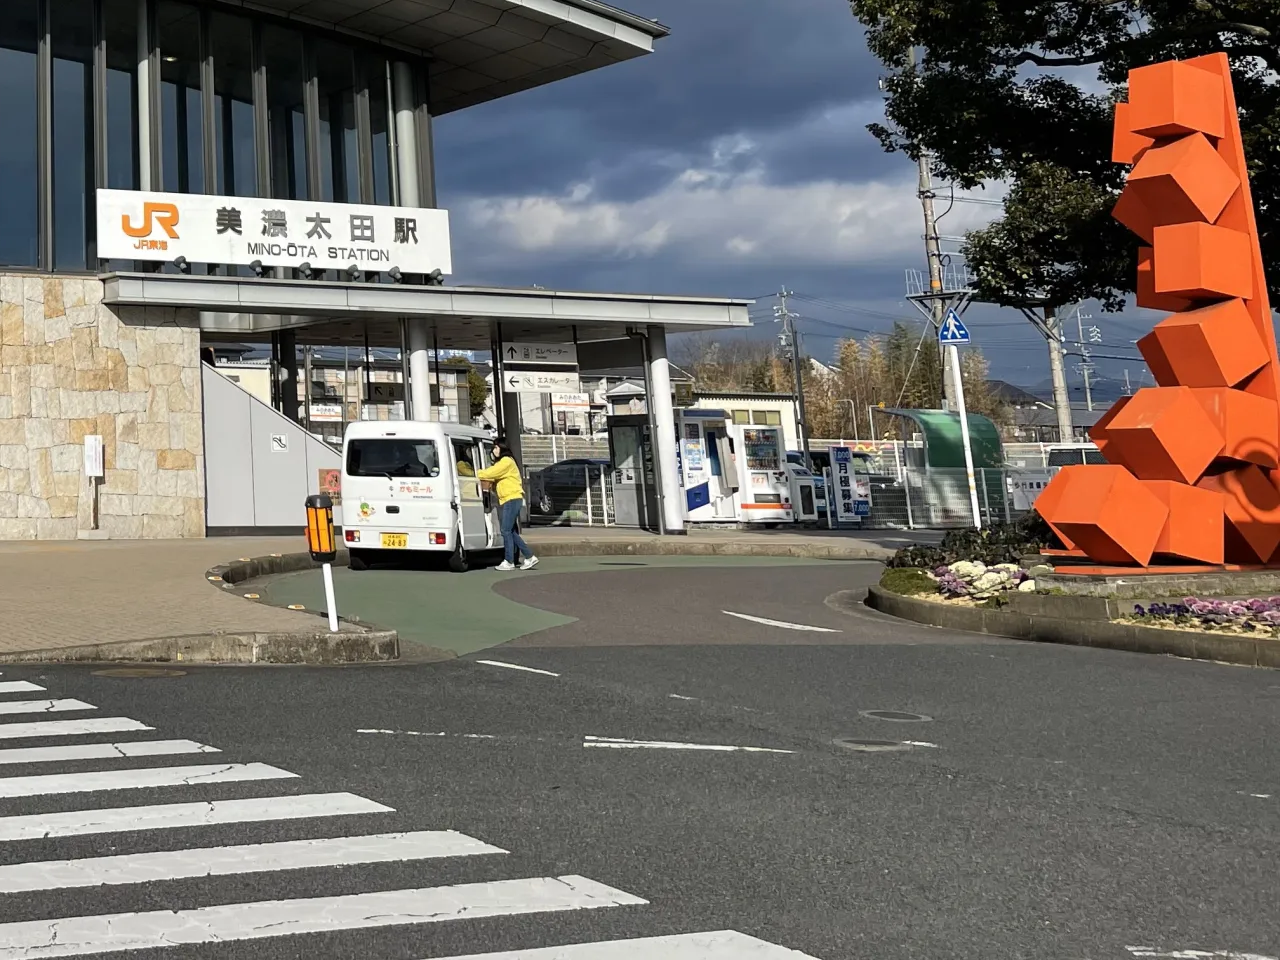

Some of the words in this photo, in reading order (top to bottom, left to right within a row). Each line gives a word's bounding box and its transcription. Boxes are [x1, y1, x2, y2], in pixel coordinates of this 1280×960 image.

[122, 202, 179, 239] JR
[216, 206, 418, 245] 美濃太田駅
[134, 239, 168, 251] JR東海
[327, 246, 390, 262] STATION
[537, 377, 576, 385] エスカレーター
[838, 462, 854, 514] 月極募集
